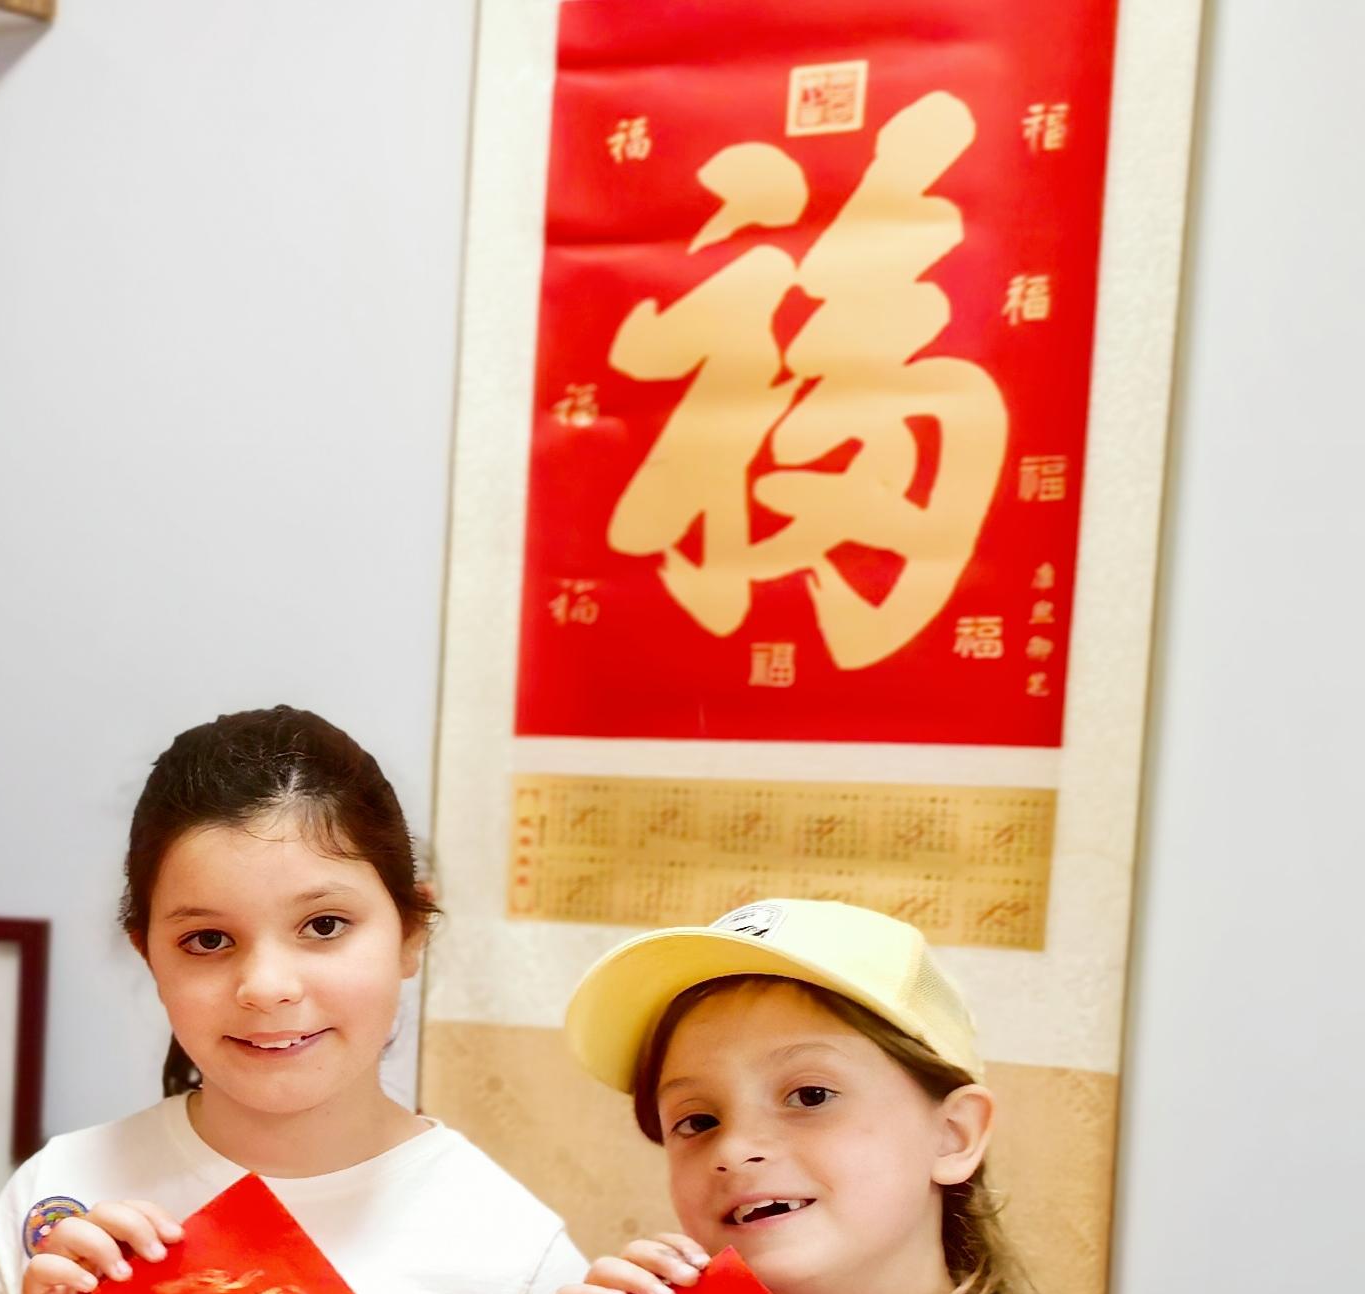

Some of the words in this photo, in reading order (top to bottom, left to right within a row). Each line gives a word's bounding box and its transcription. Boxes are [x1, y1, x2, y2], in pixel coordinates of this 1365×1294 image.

[606, 116, 653, 164] 福
[1001, 273, 1051, 327] 福
[607, 90, 1009, 671] 福
